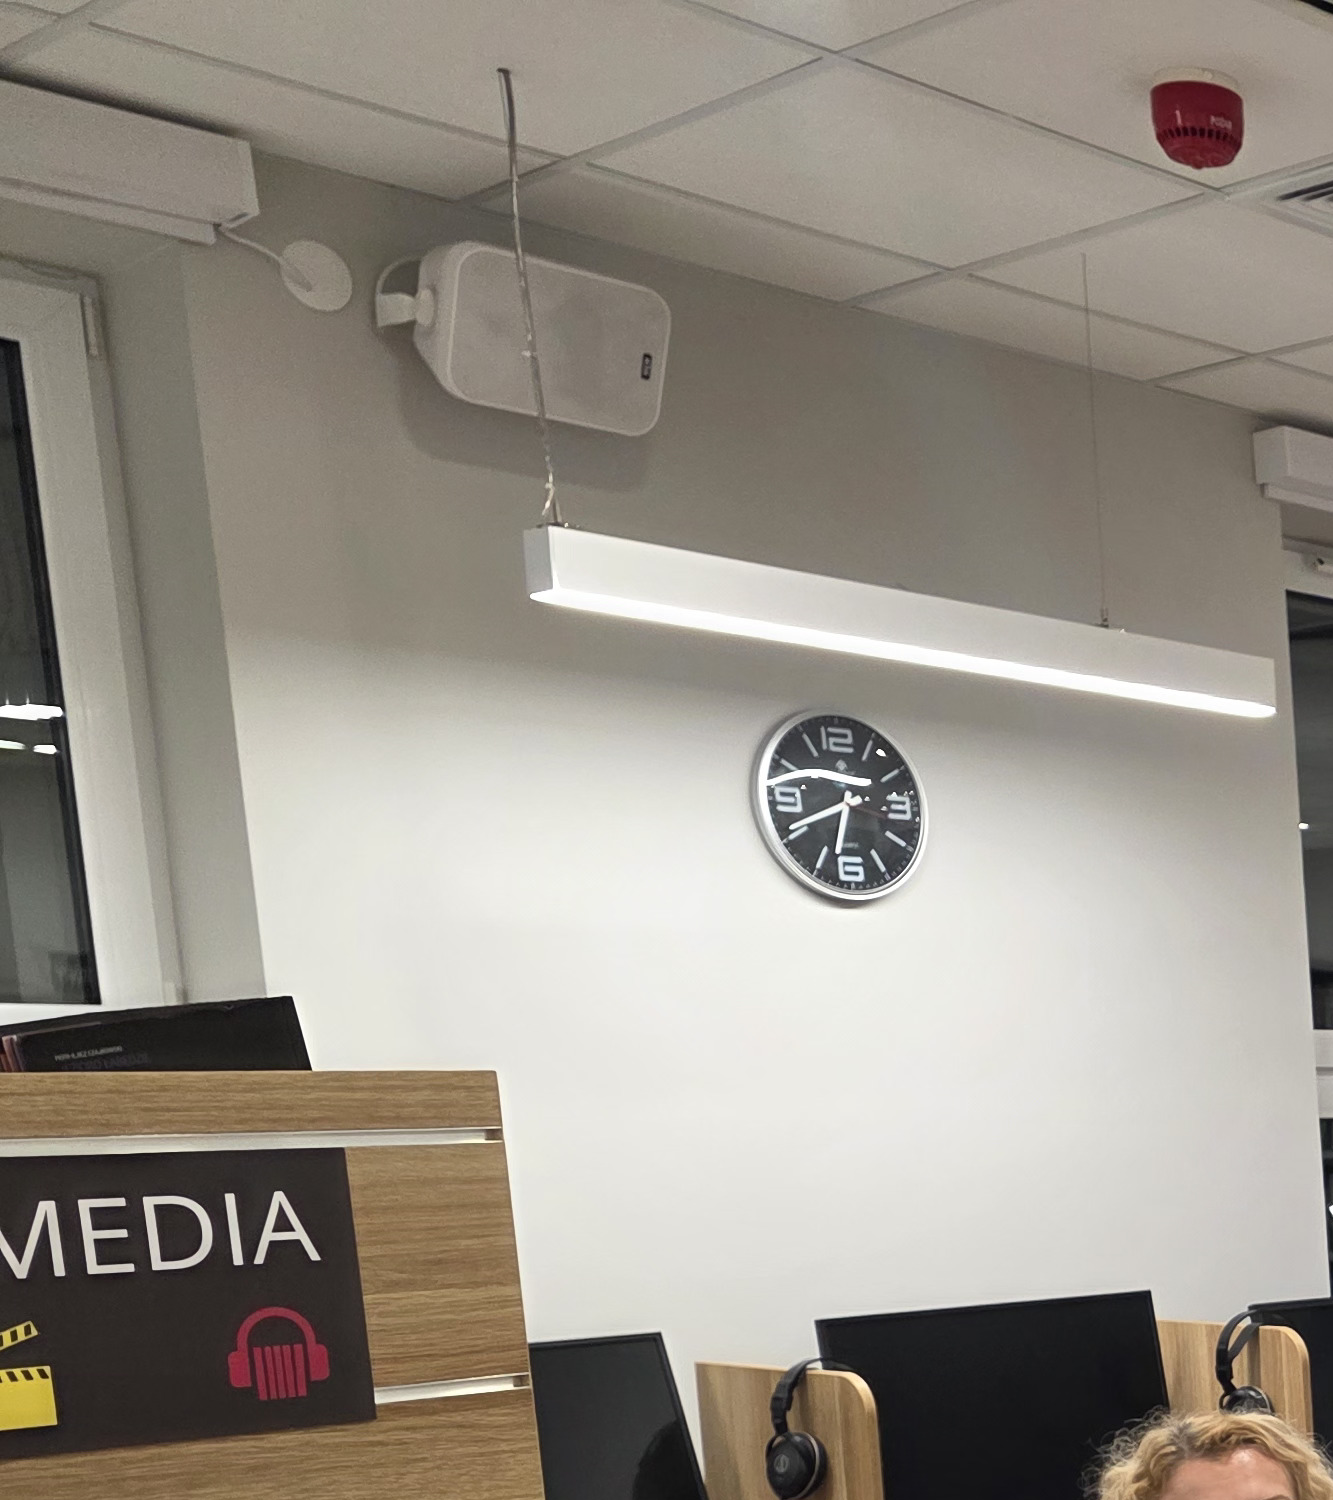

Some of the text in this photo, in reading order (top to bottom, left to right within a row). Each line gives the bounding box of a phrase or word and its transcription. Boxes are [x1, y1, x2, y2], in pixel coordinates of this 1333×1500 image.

[821, 725, 855, 754] 12
[774, 787, 803, 813] 9
[887, 796, 911, 821] 3
[838, 855, 866, 882] 6
[0, 1190, 321, 1280] MEDIA
